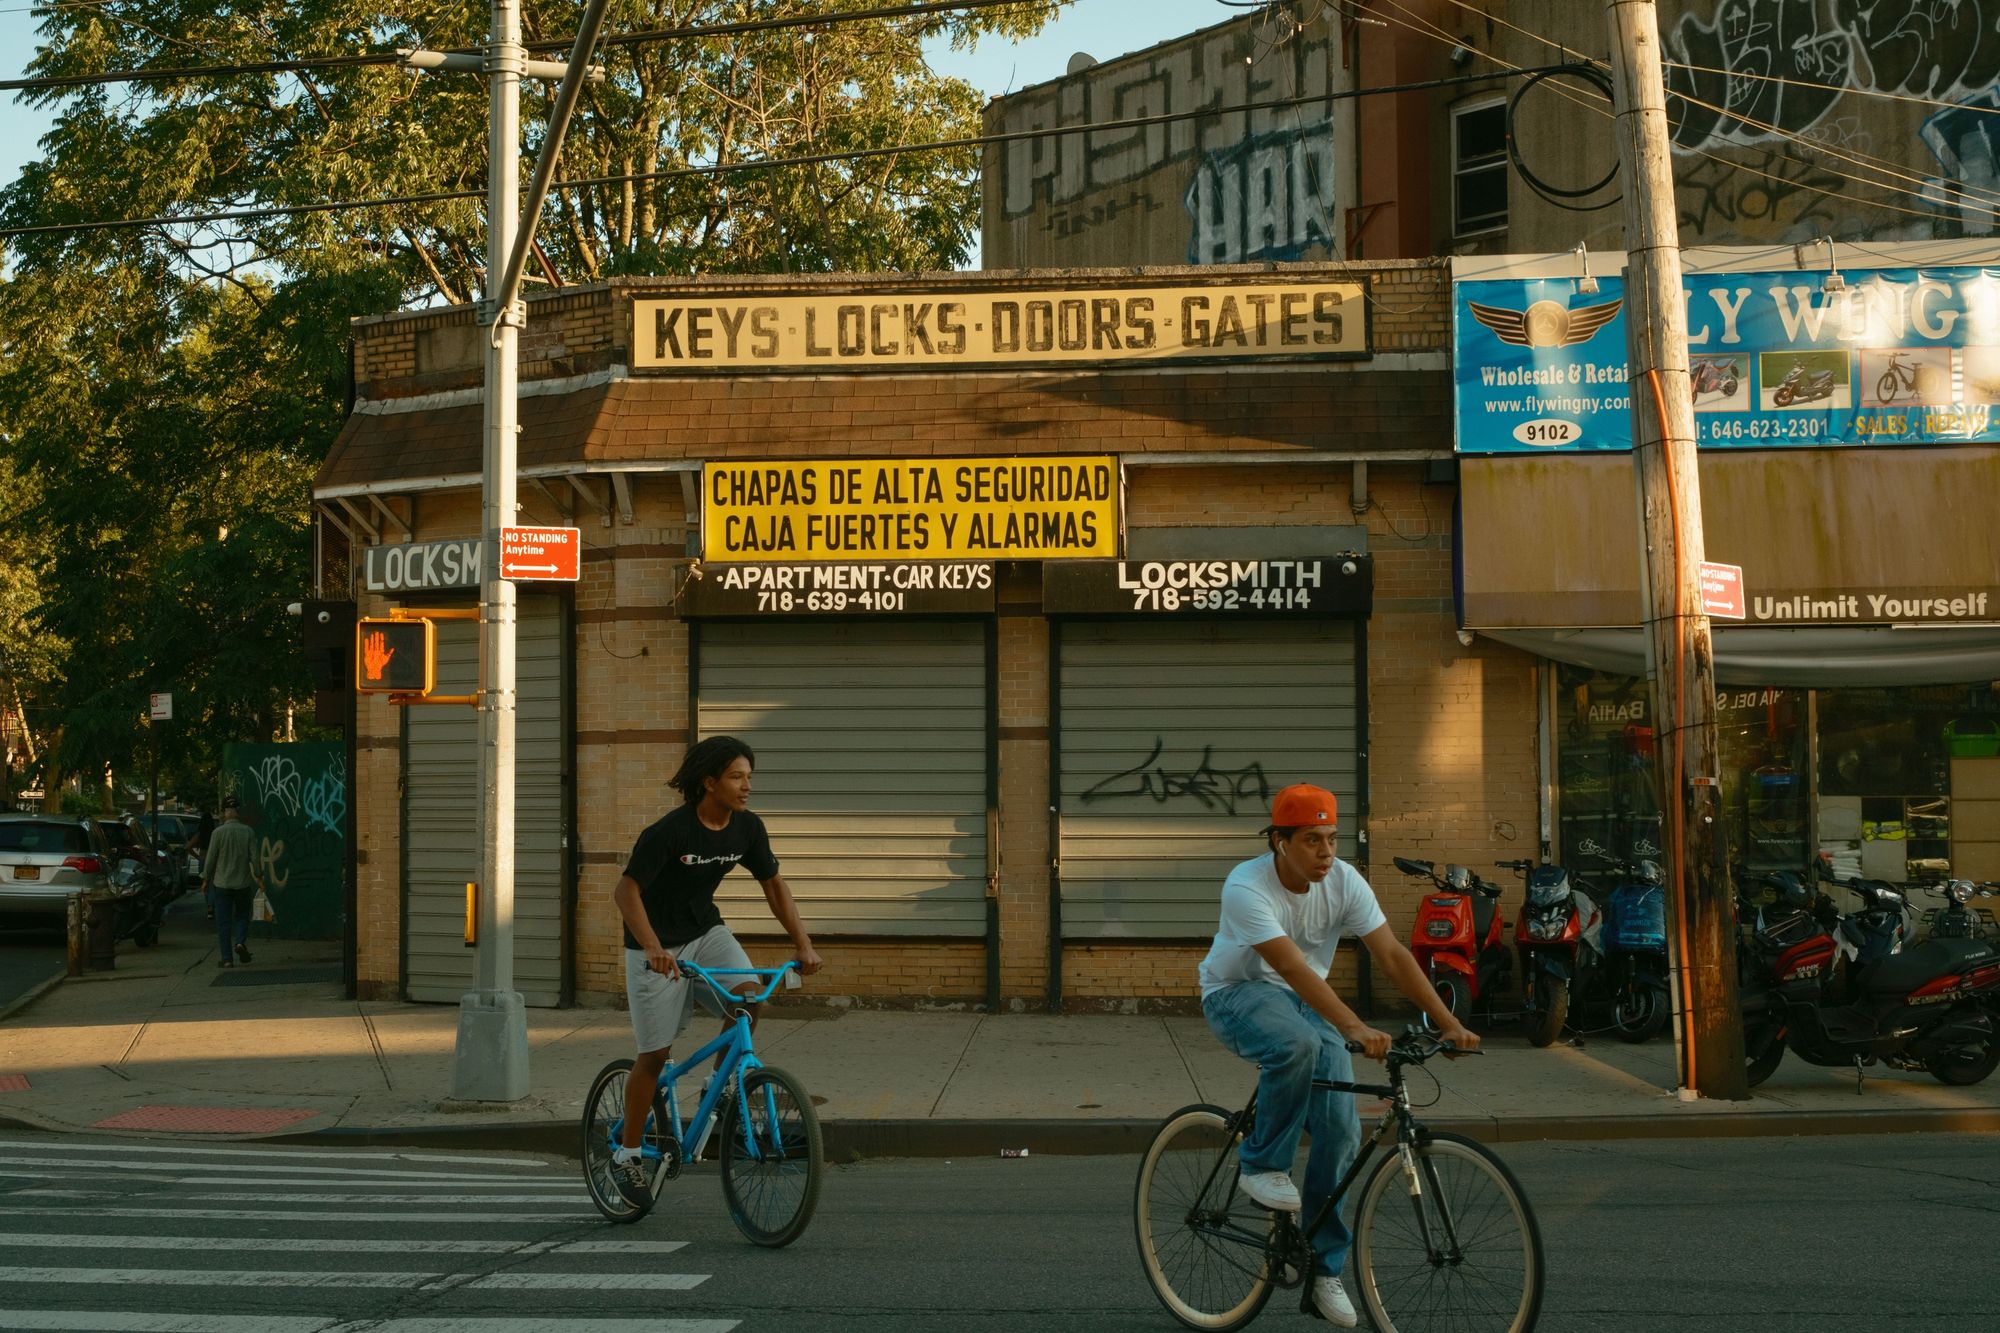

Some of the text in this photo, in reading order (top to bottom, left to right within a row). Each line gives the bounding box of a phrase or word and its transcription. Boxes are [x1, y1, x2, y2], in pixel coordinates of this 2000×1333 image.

[655, 291, 1343, 359] KEYS LOCKS DOORS GATES
[1684, 287, 1752, 345] LY
[1769, 282, 1959, 343] WING
[1481, 362, 1629, 386] Wholesale & Retai
[1527, 424, 1569, 440] 9102
[1712, 418, 1828, 439] 646-623-2301
[1856, 415, 1907, 435] SALES
[712, 465, 1110, 507] CHAPAS DE ALTA SEGURIDAD
[505, 533, 568, 544] NO STANDING
[725, 510, 1097, 552] CAJA FUERTES Y ALARMAS
[505, 545, 544, 556] Anytime
[367, 541, 482, 590] LOCKSM
[724, 564, 992, 590] APARTMENT CAR KEYS
[1118, 561, 1321, 589] LOCKSMITH
[757, 591, 904, 612] 718-639-4101
[1133, 588, 1311, 610] 718-592-4414
[1754, 592, 1987, 620] Unlimit Yourself
